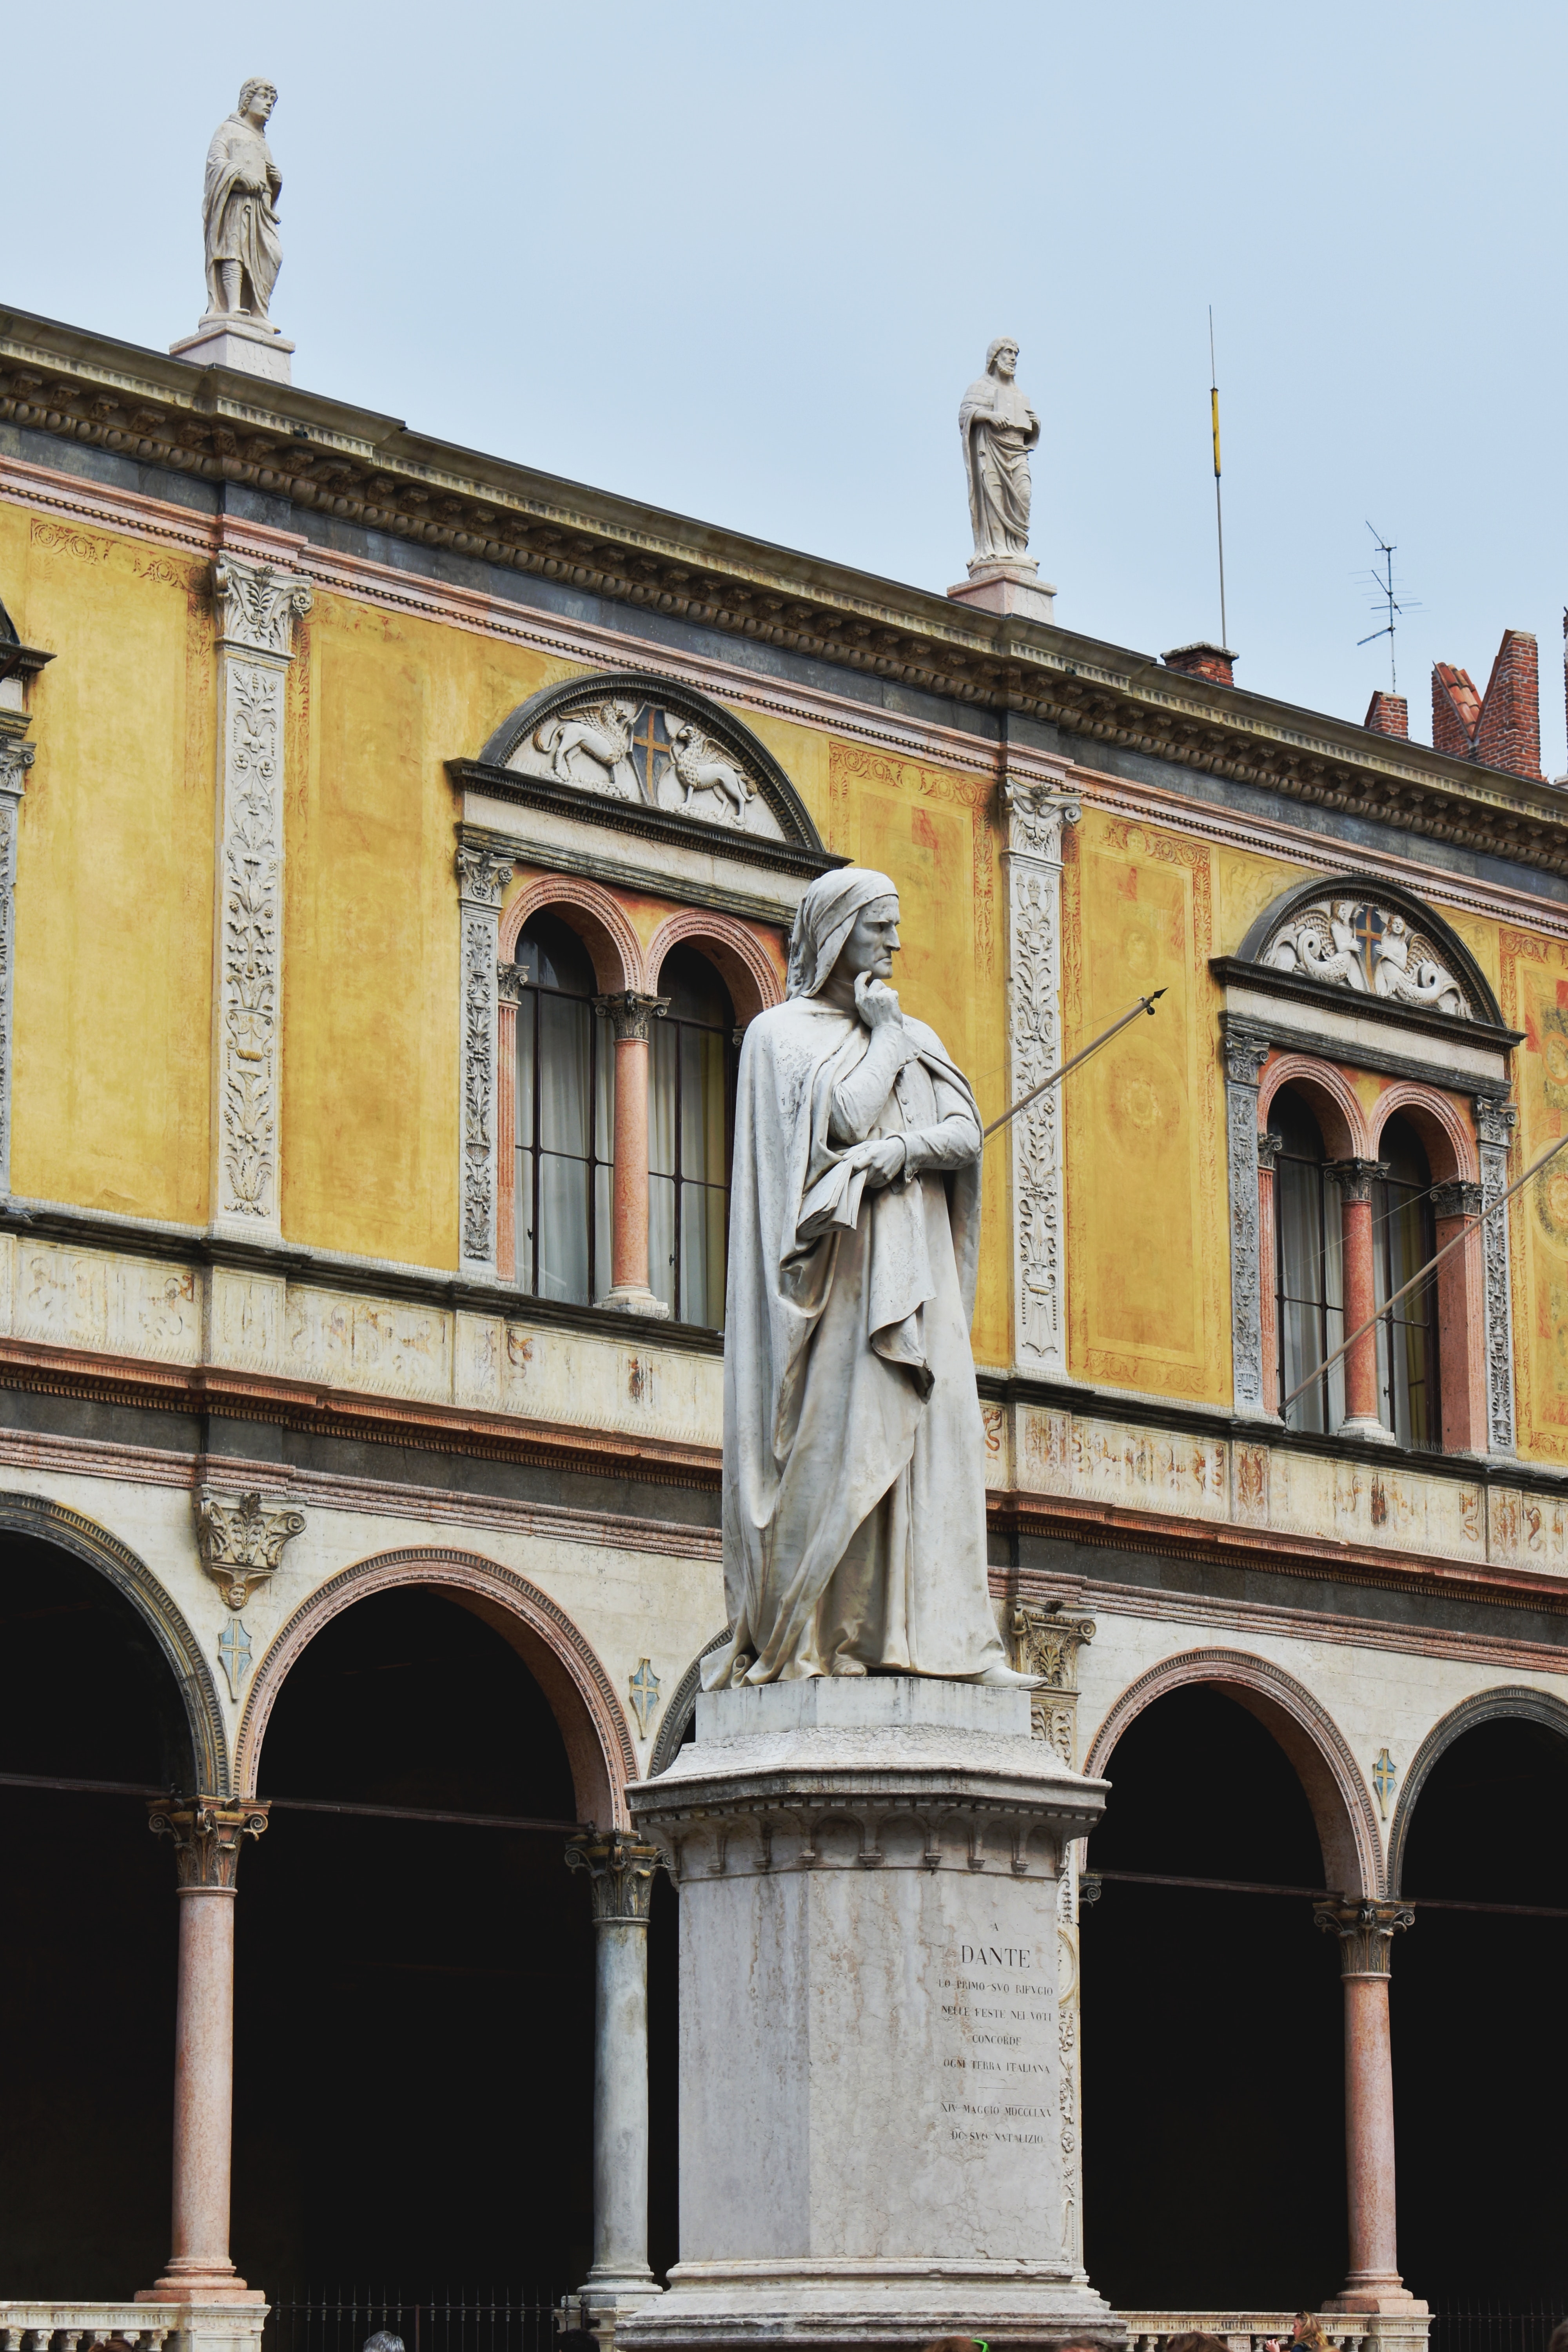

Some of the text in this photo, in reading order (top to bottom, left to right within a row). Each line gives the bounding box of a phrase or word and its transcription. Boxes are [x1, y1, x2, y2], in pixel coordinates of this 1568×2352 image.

[992, 1922, 998, 1931] A
[962, 1945, 1030, 1967] DANTE
[939, 1979, 1053, 1996] LO PRIMO SVO RIFVGIO
[942, 2005, 1051, 2021] NELLE FESTE NEI VOTI
[972, 2034, 1021, 2045] CONCORDE
[944, 2059, 1050, 2073] OGNI TERRA ITALIANA
[941, 2102, 1051, 2117] XIV MAGGIO MDCCCLXV
[970, 2132, 987, 2141] SVO
[995, 2133, 1043, 2143] NATALIZIO
